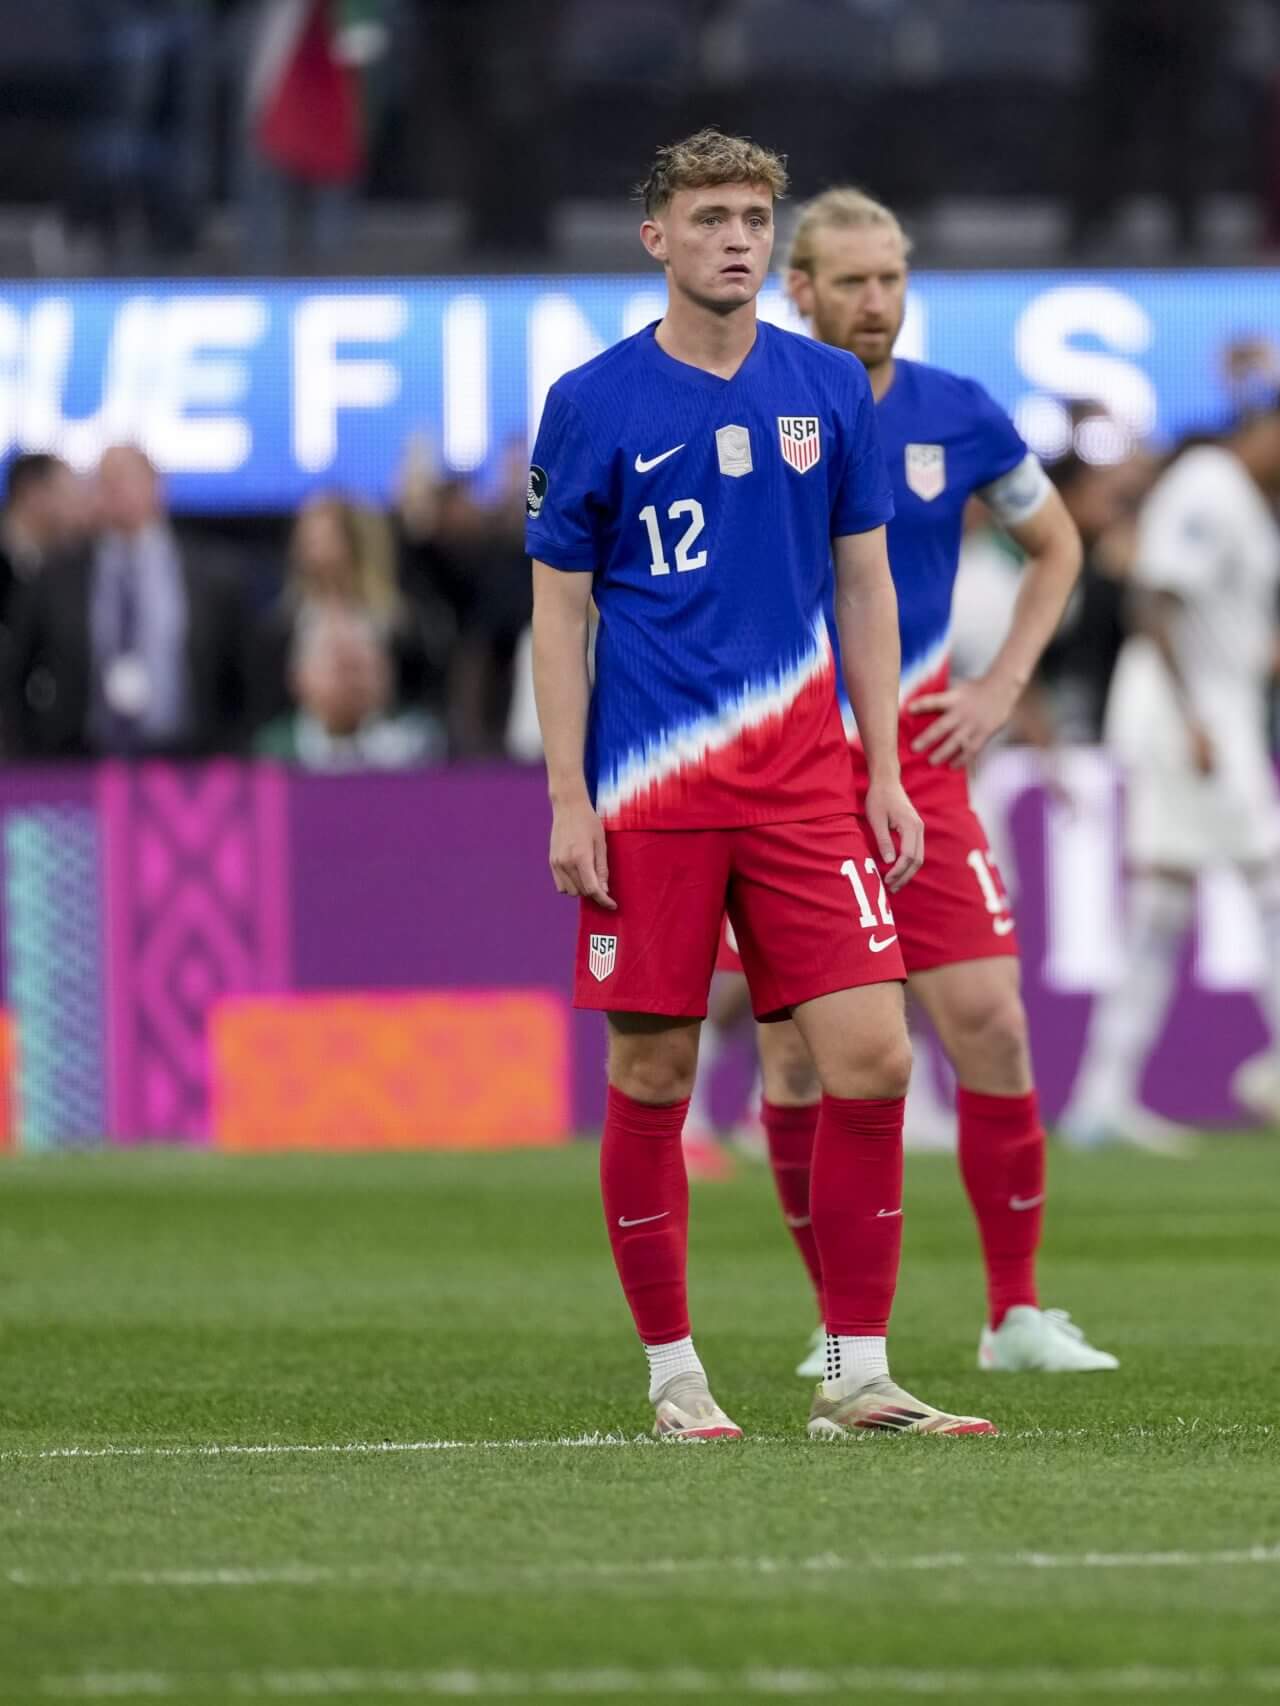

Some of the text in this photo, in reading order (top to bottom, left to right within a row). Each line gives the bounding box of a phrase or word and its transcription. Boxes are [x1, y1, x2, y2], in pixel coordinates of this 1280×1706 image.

[0, 285, 1157, 473] UE FIS
[780, 419, 817, 441] USA
[638, 498, 707, 576] 12
[967, 849, 1008, 914] 1
[591, 936, 615, 955] USA
